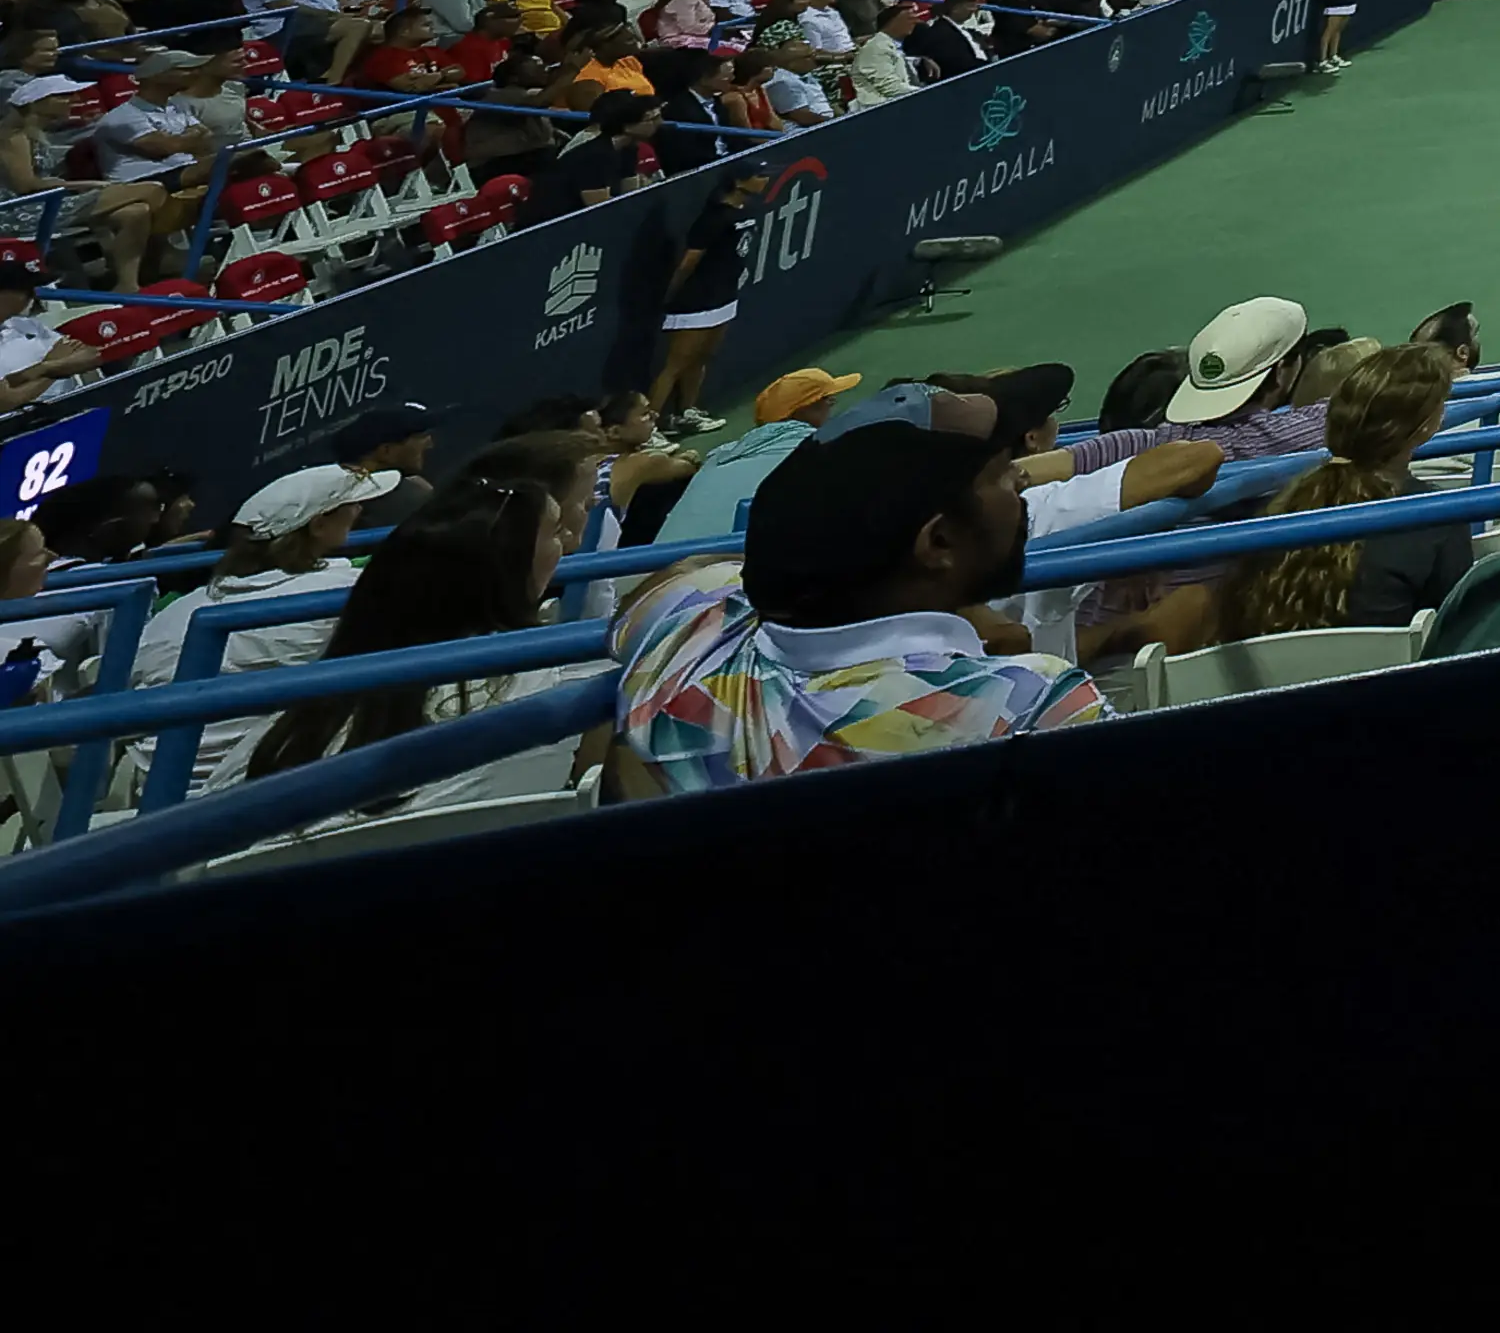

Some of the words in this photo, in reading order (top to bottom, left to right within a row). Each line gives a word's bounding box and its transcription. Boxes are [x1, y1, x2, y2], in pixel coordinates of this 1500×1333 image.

[1141, 57, 1236, 124] MUBADALA
[905, 138, 1055, 236] MUBADALA
[737, 179, 822, 291] iti
[534, 306, 597, 350] KASTLE
[258, 356, 390, 445] TENNIS
[18, 441, 76, 502] 82
